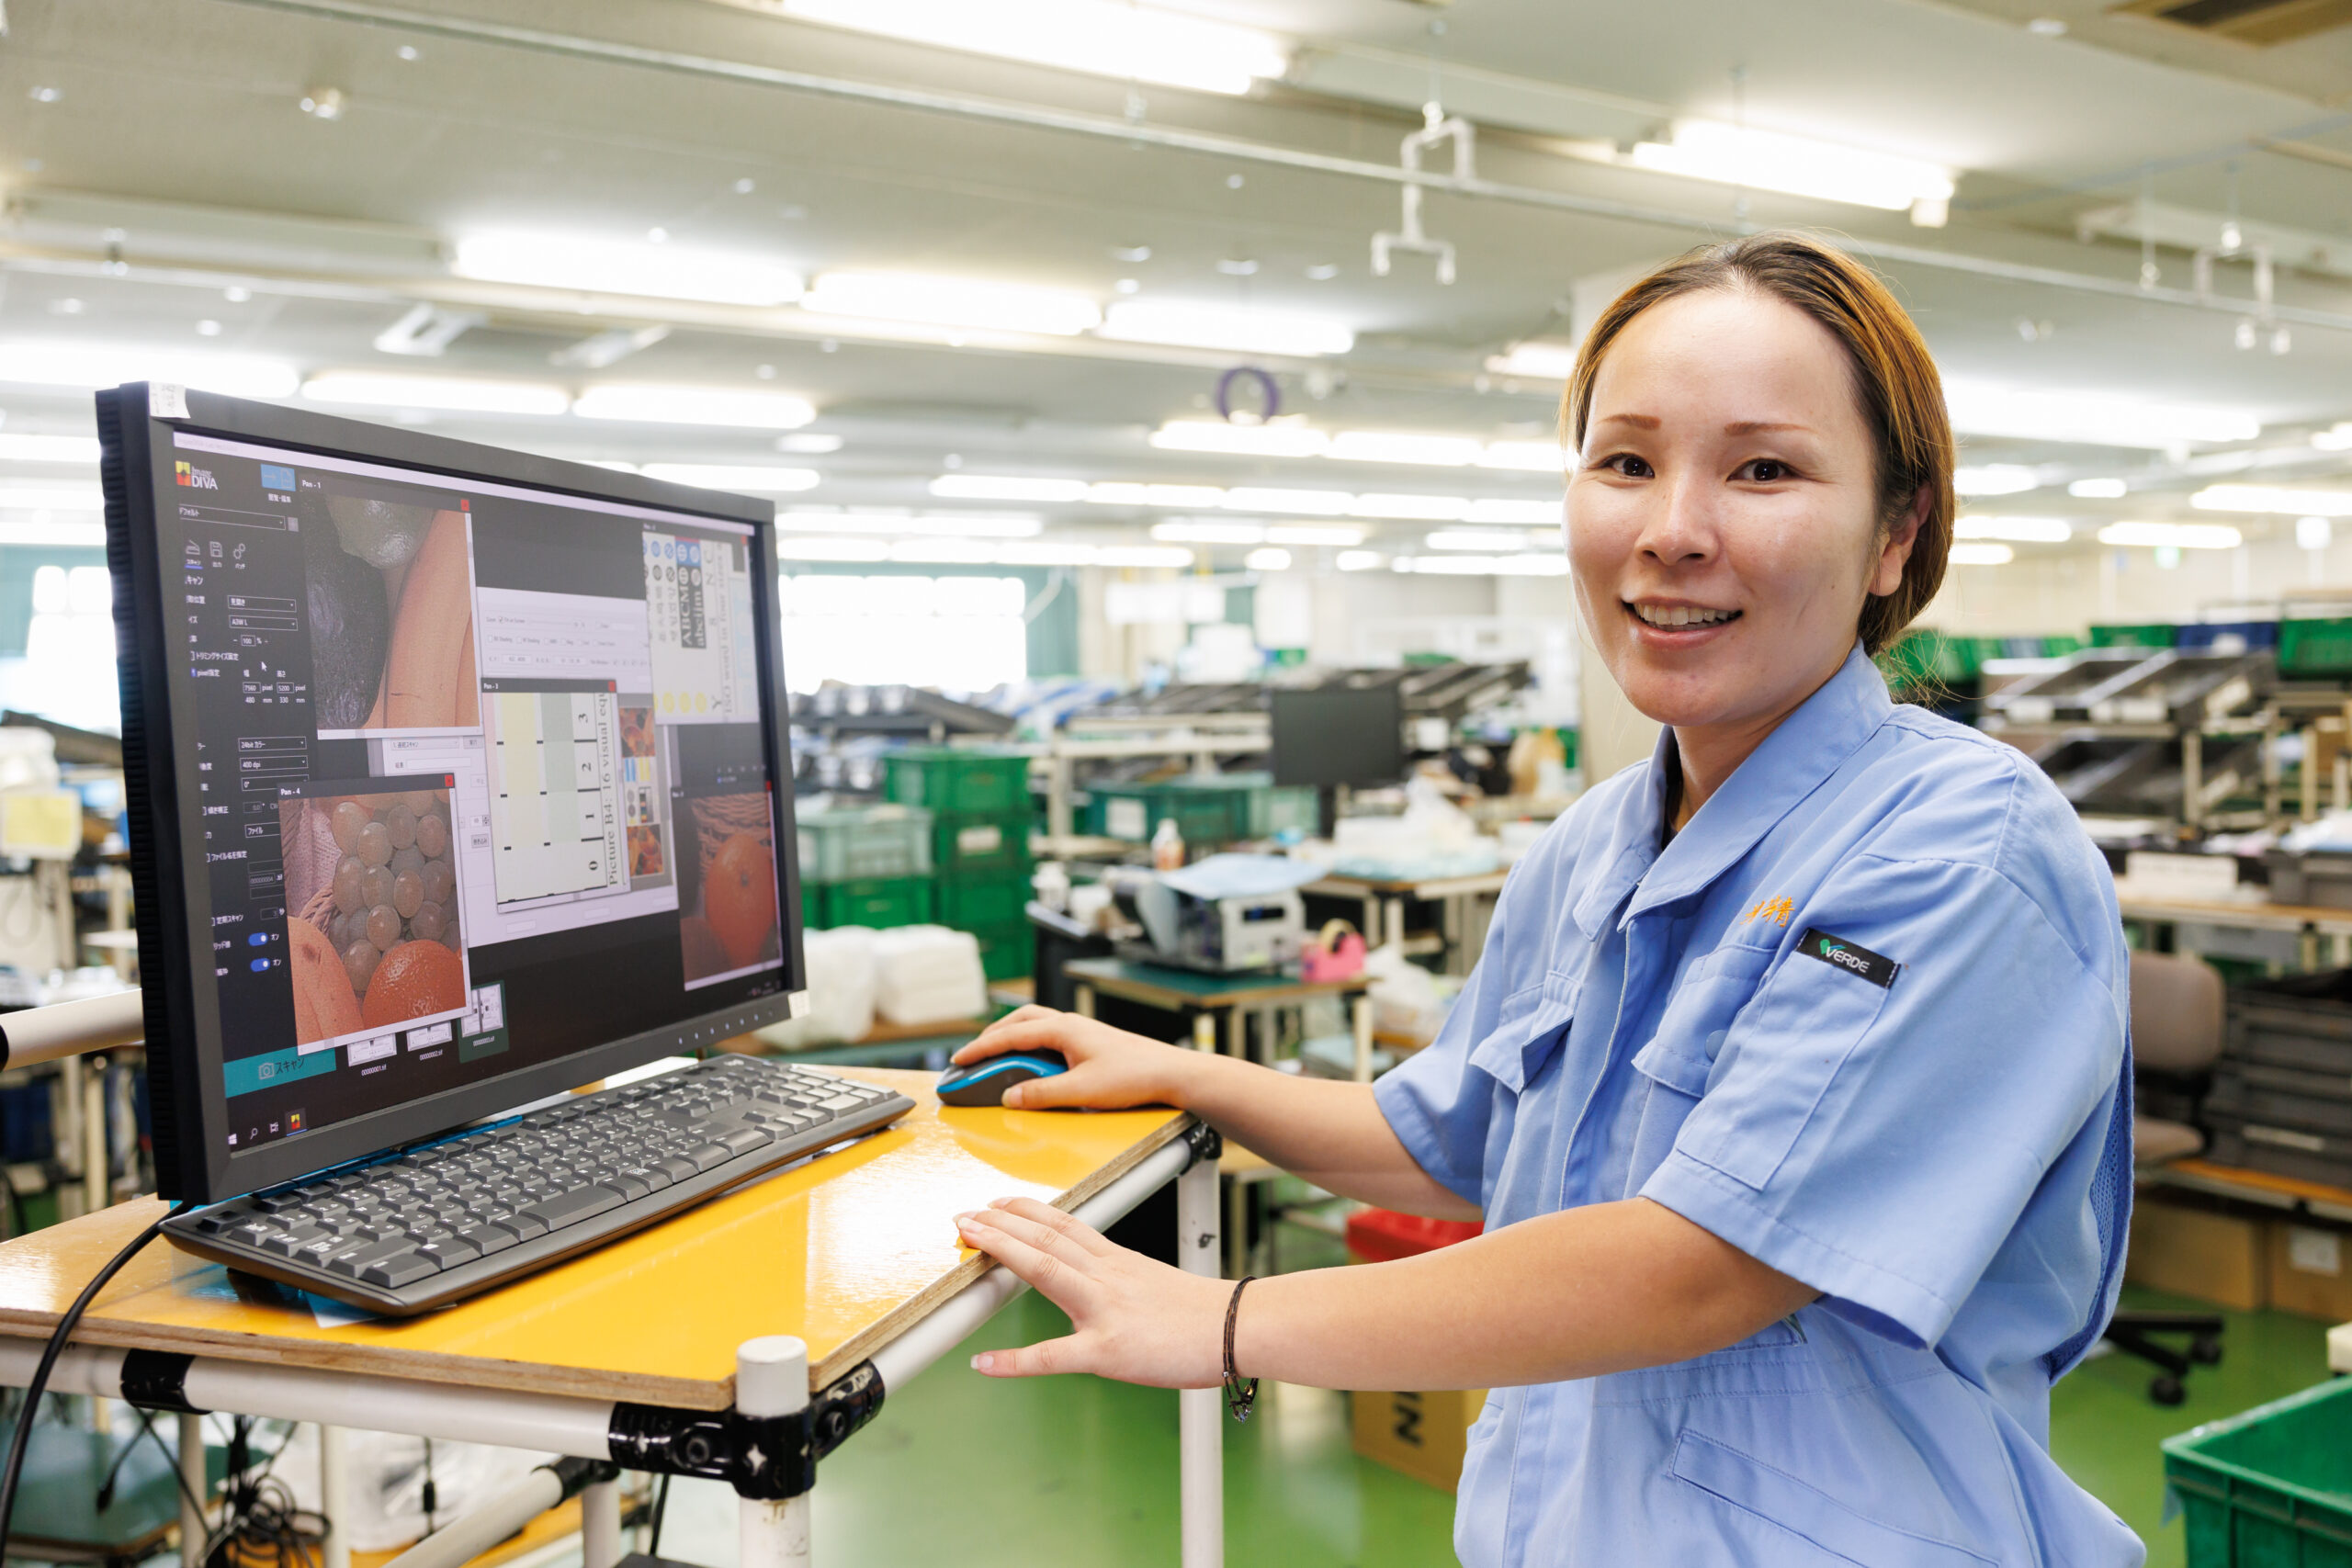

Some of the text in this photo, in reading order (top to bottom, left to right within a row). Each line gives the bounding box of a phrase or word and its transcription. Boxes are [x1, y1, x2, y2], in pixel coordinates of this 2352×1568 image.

[191, 475, 219, 491] DIVA
[302, 479, 313, 488] Pan
[185, 575, 203, 585] キャン
[578, 713, 589, 723] 3
[597, 722, 610, 767] visual
[581, 761, 592, 772] 2
[601, 773, 612, 790] 16
[603, 797, 615, 825] B4:
[588, 860, 599, 871] 0
[607, 829, 619, 886] Picture
[1826, 947, 1871, 974] VERDE
[275, 1057, 305, 1075] スキャン
